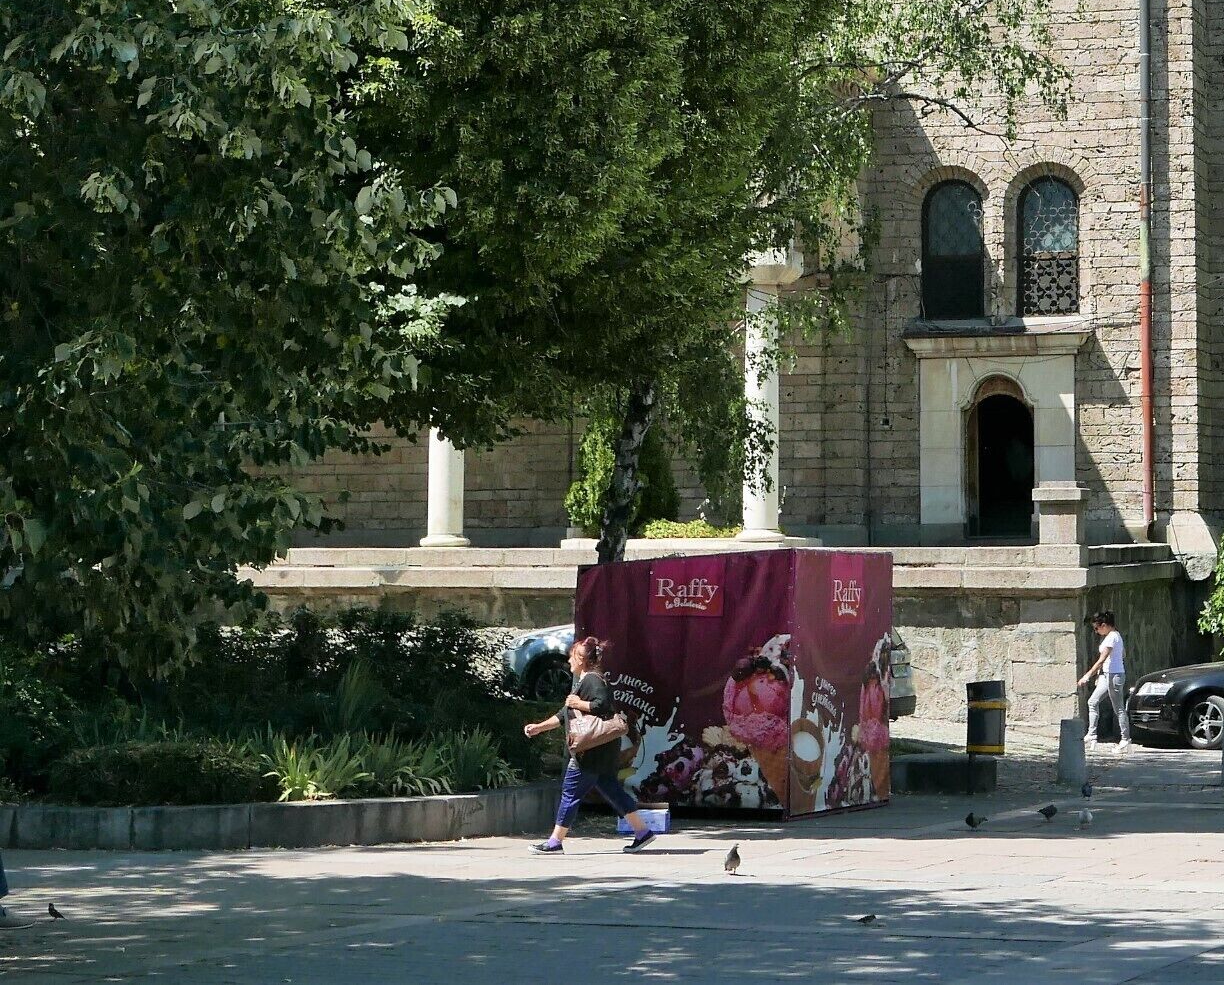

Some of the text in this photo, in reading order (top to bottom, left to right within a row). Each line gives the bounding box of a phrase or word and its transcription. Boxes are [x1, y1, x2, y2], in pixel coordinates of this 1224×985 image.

[655, 578, 719, 603] Raffy
[833, 579, 861, 608] Raffy
[610, 673, 654, 694] много
[613, 689, 656, 716] етана
